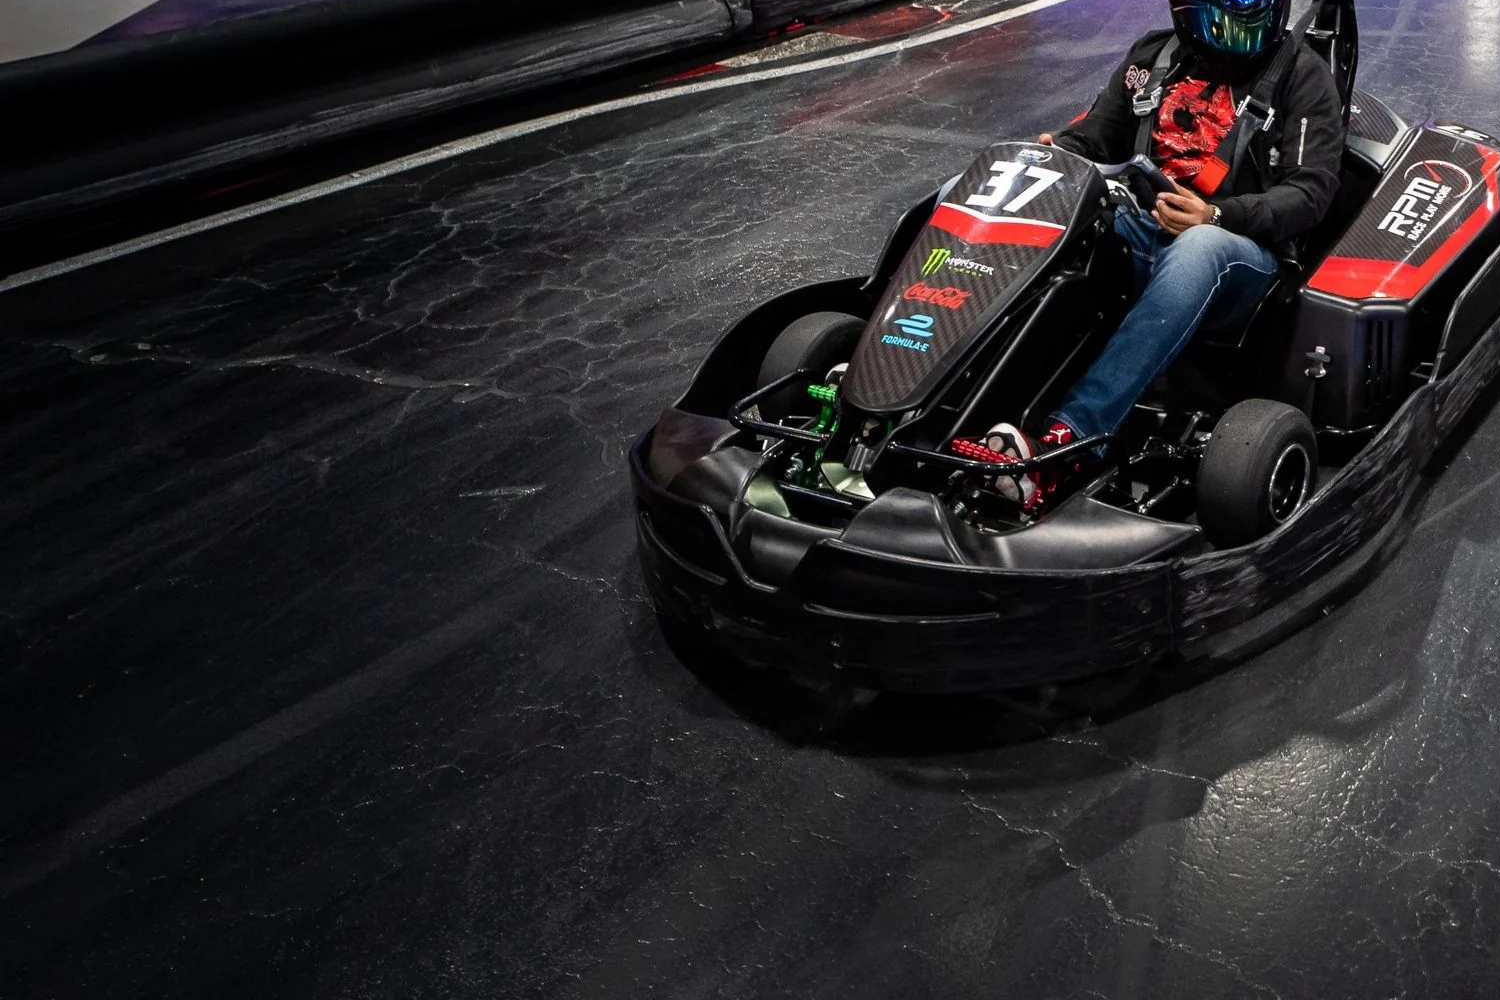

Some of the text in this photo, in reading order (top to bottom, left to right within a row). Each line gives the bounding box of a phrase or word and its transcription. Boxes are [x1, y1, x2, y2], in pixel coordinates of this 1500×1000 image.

[964, 160, 1064, 213] 37
[1377, 177, 1440, 237] RPM
[1406, 184, 1453, 241] RACE PLAY MORE
[944, 256, 995, 276] MONSTER
